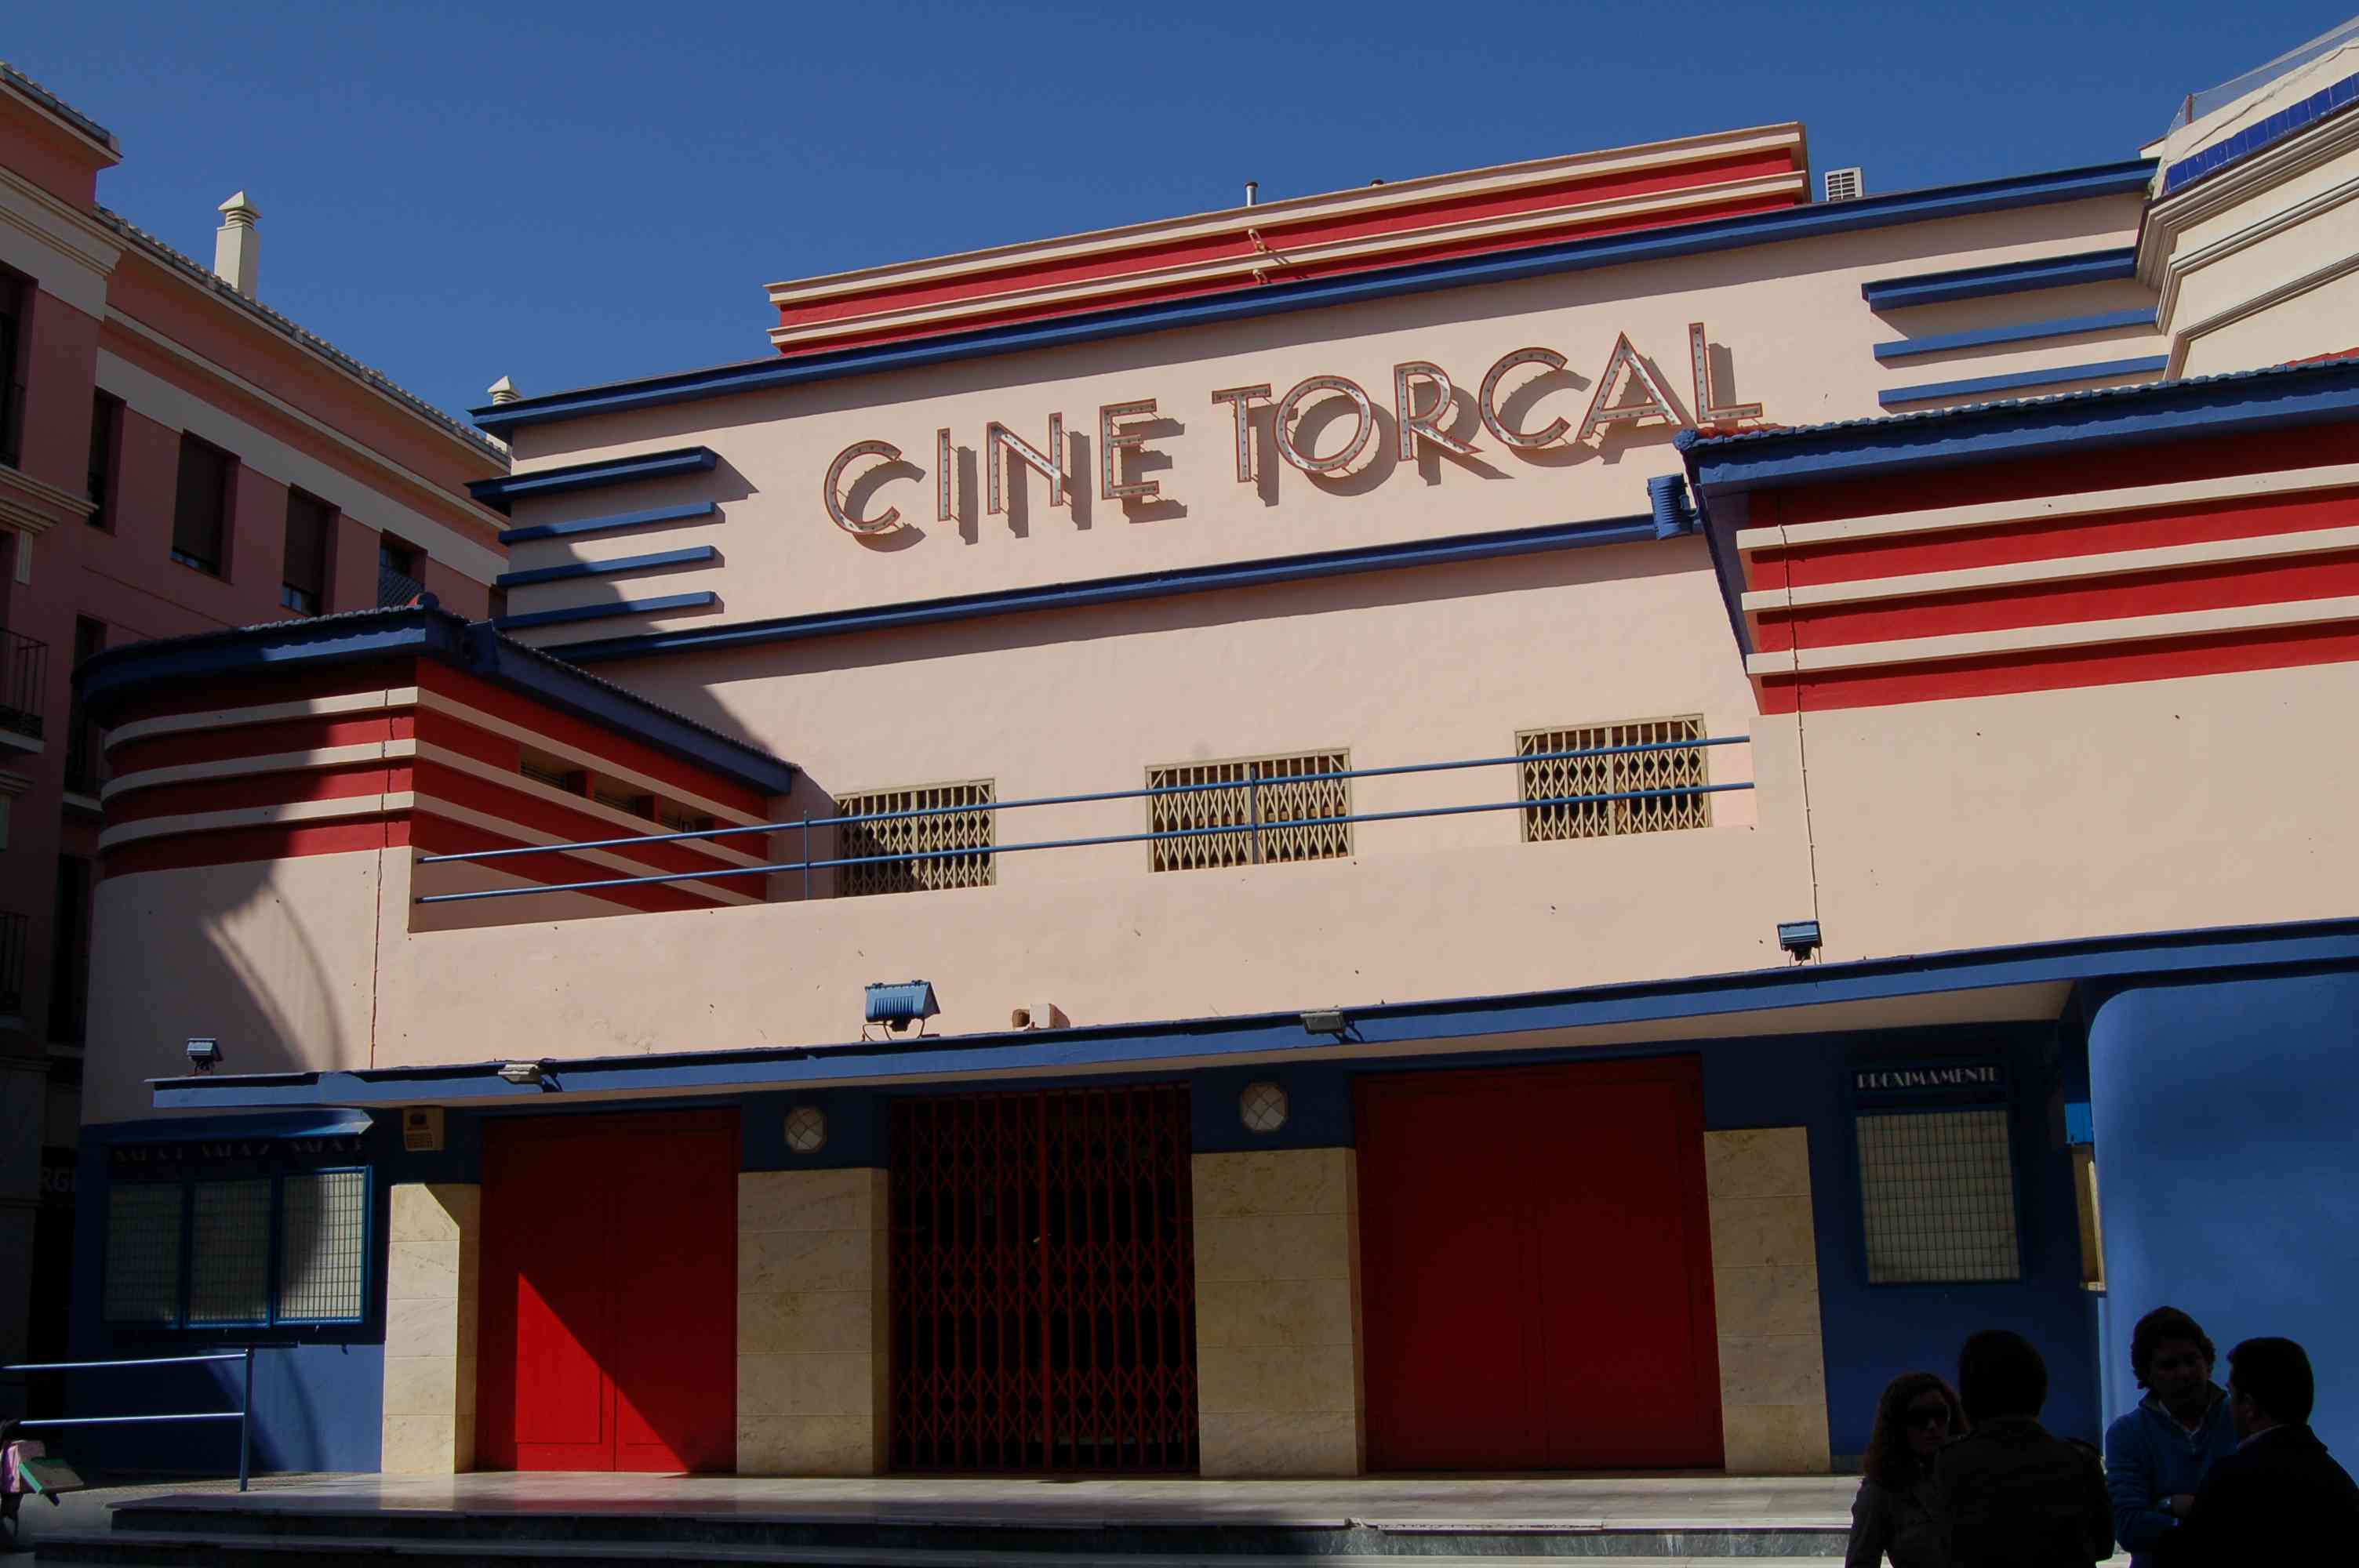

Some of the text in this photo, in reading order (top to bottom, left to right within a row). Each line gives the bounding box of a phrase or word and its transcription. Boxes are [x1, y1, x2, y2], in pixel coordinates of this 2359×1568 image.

[823, 322, 1763, 535] CINE TORCAL
[1857, 1066, 1997, 1090] PROXIMAMENTE
